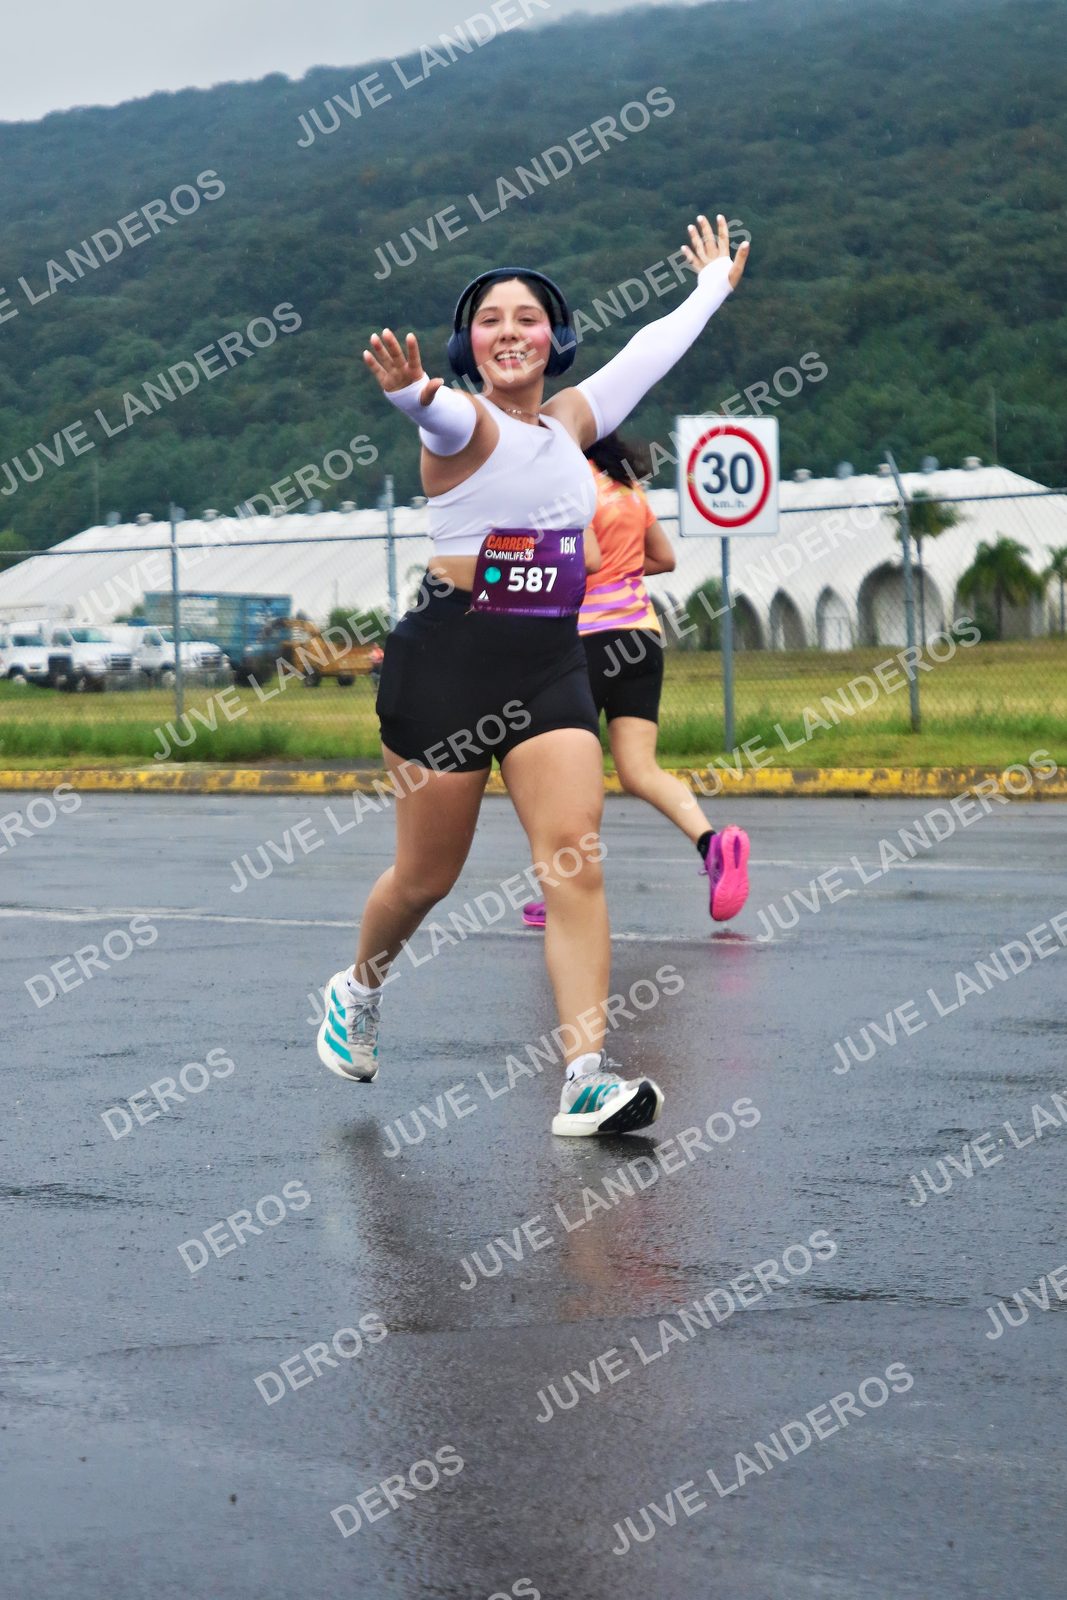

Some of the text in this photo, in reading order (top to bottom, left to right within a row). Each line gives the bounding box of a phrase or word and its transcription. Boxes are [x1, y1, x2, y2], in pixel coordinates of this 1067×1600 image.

[702, 451, 755, 495] 30
[485, 549, 525, 561] OMNILIFE
[560, 536, 577, 555] 16K
[507, 567, 558, 593] 587
